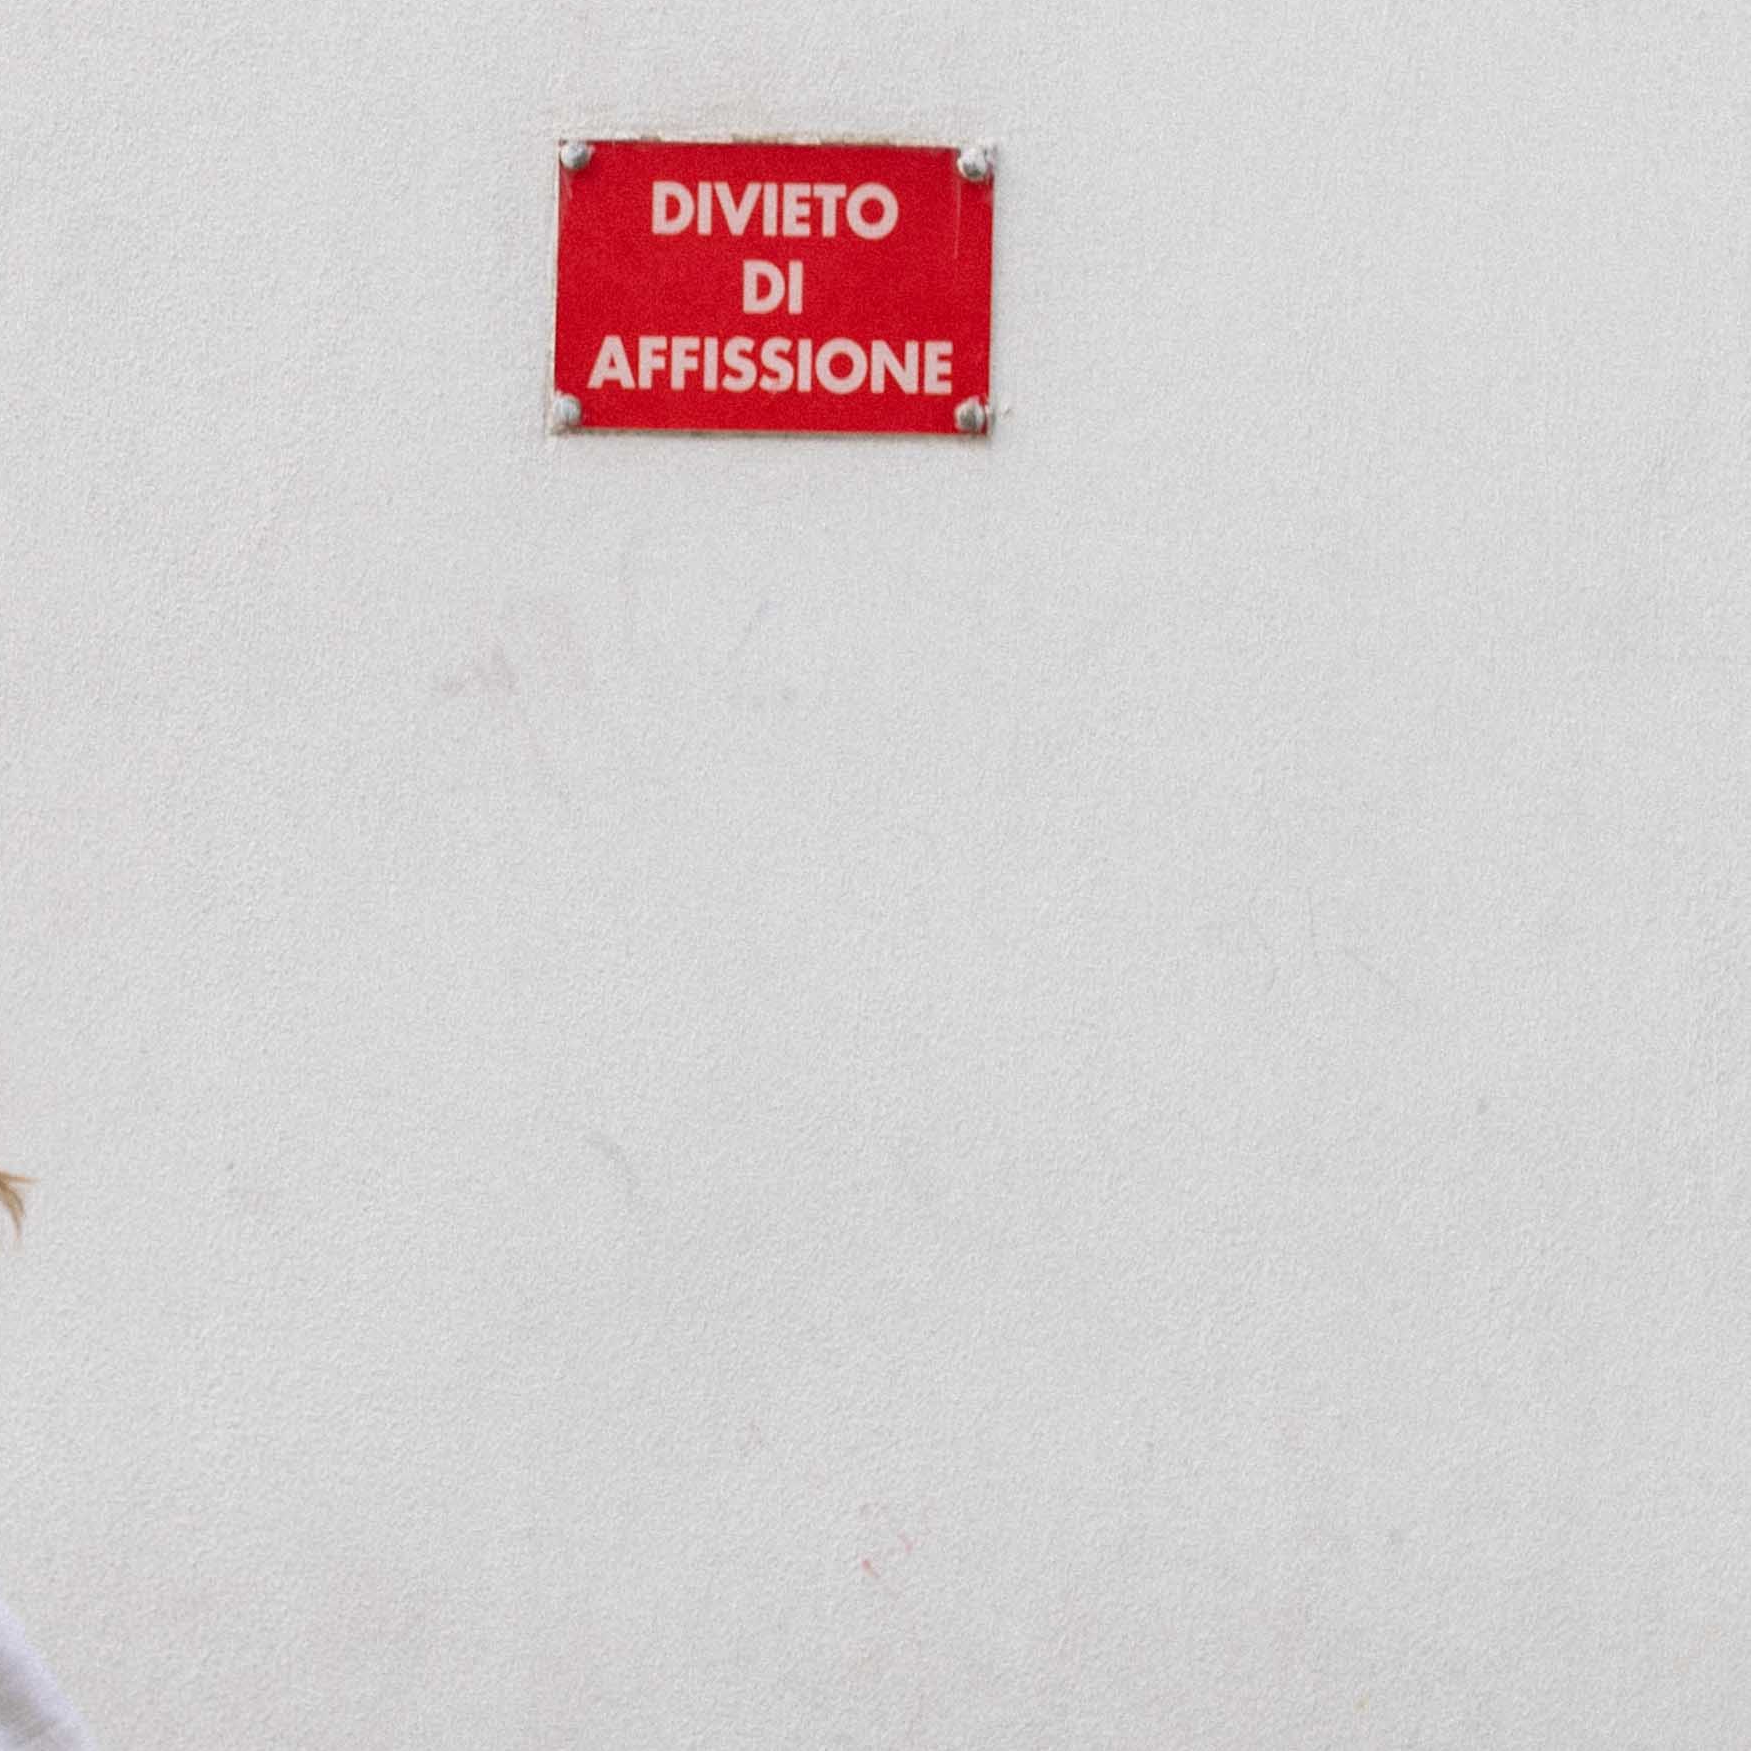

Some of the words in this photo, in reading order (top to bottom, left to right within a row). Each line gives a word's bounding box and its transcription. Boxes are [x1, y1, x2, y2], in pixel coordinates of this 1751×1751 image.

[651, 180, 899, 240] DIVIETO
[742, 259, 804, 315] DI
[587, 335, 954, 396] AFFISSIONE
